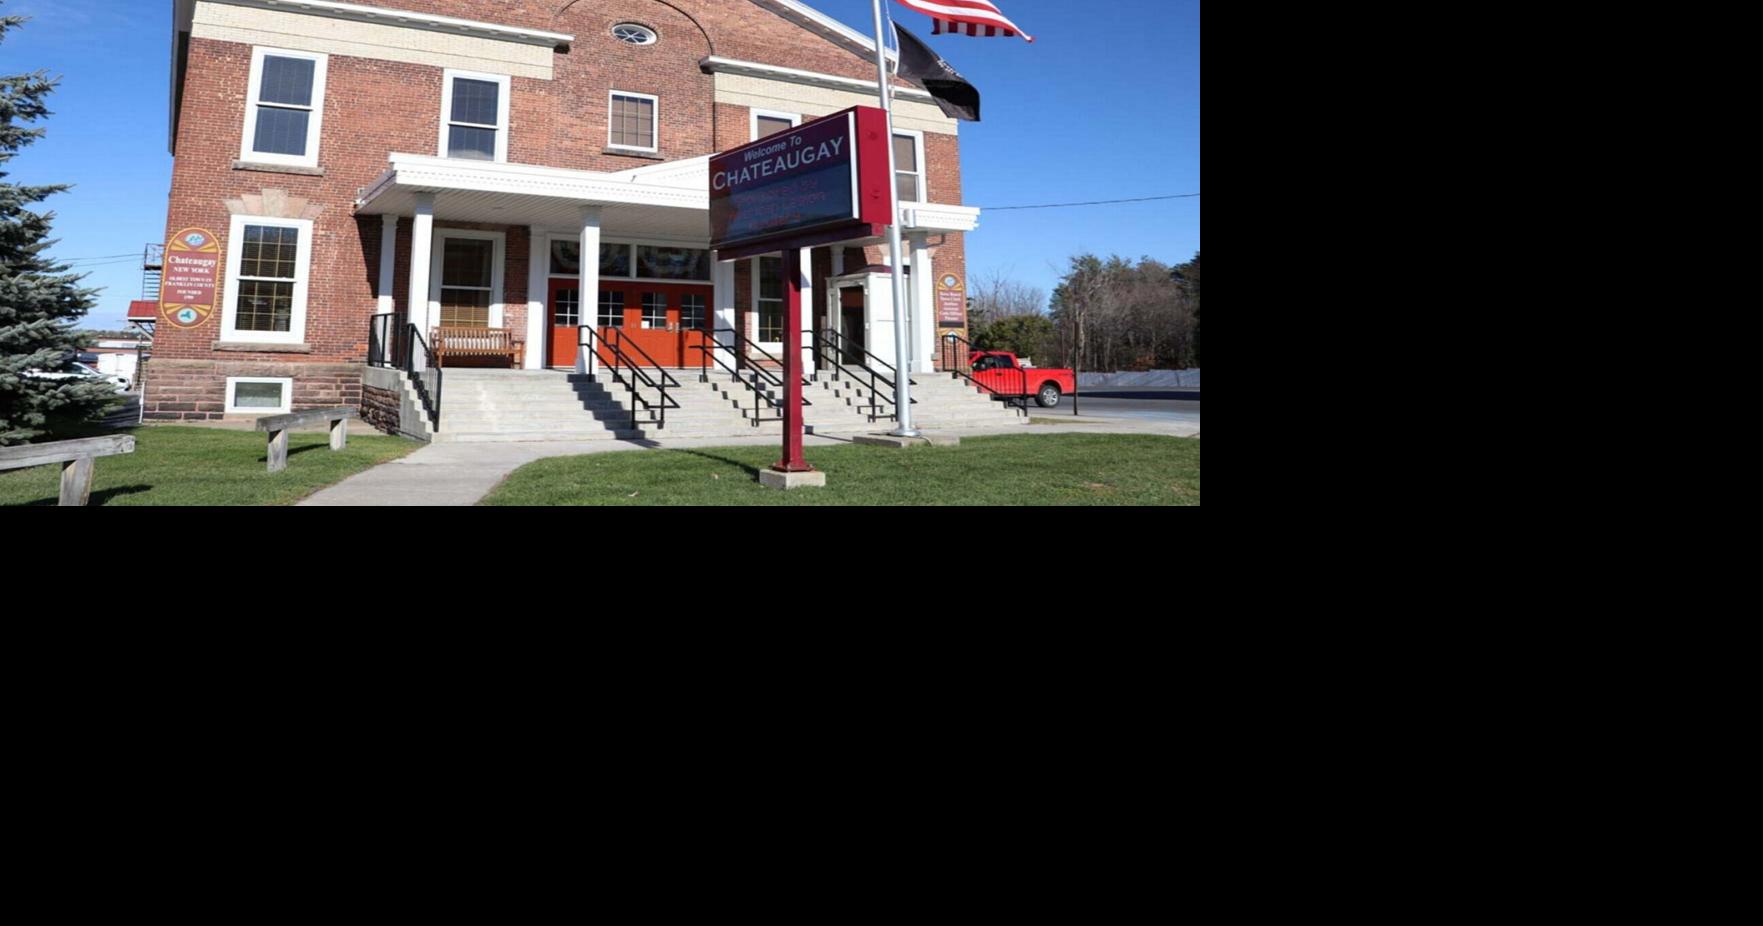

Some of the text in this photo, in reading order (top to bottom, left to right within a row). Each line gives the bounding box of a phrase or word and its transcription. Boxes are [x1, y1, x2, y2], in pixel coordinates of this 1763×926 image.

[743, 135, 802, 162] Welcome To
[712, 135, 844, 190] CHATEAUGAY
[168, 255, 216, 268] Chateaugay
